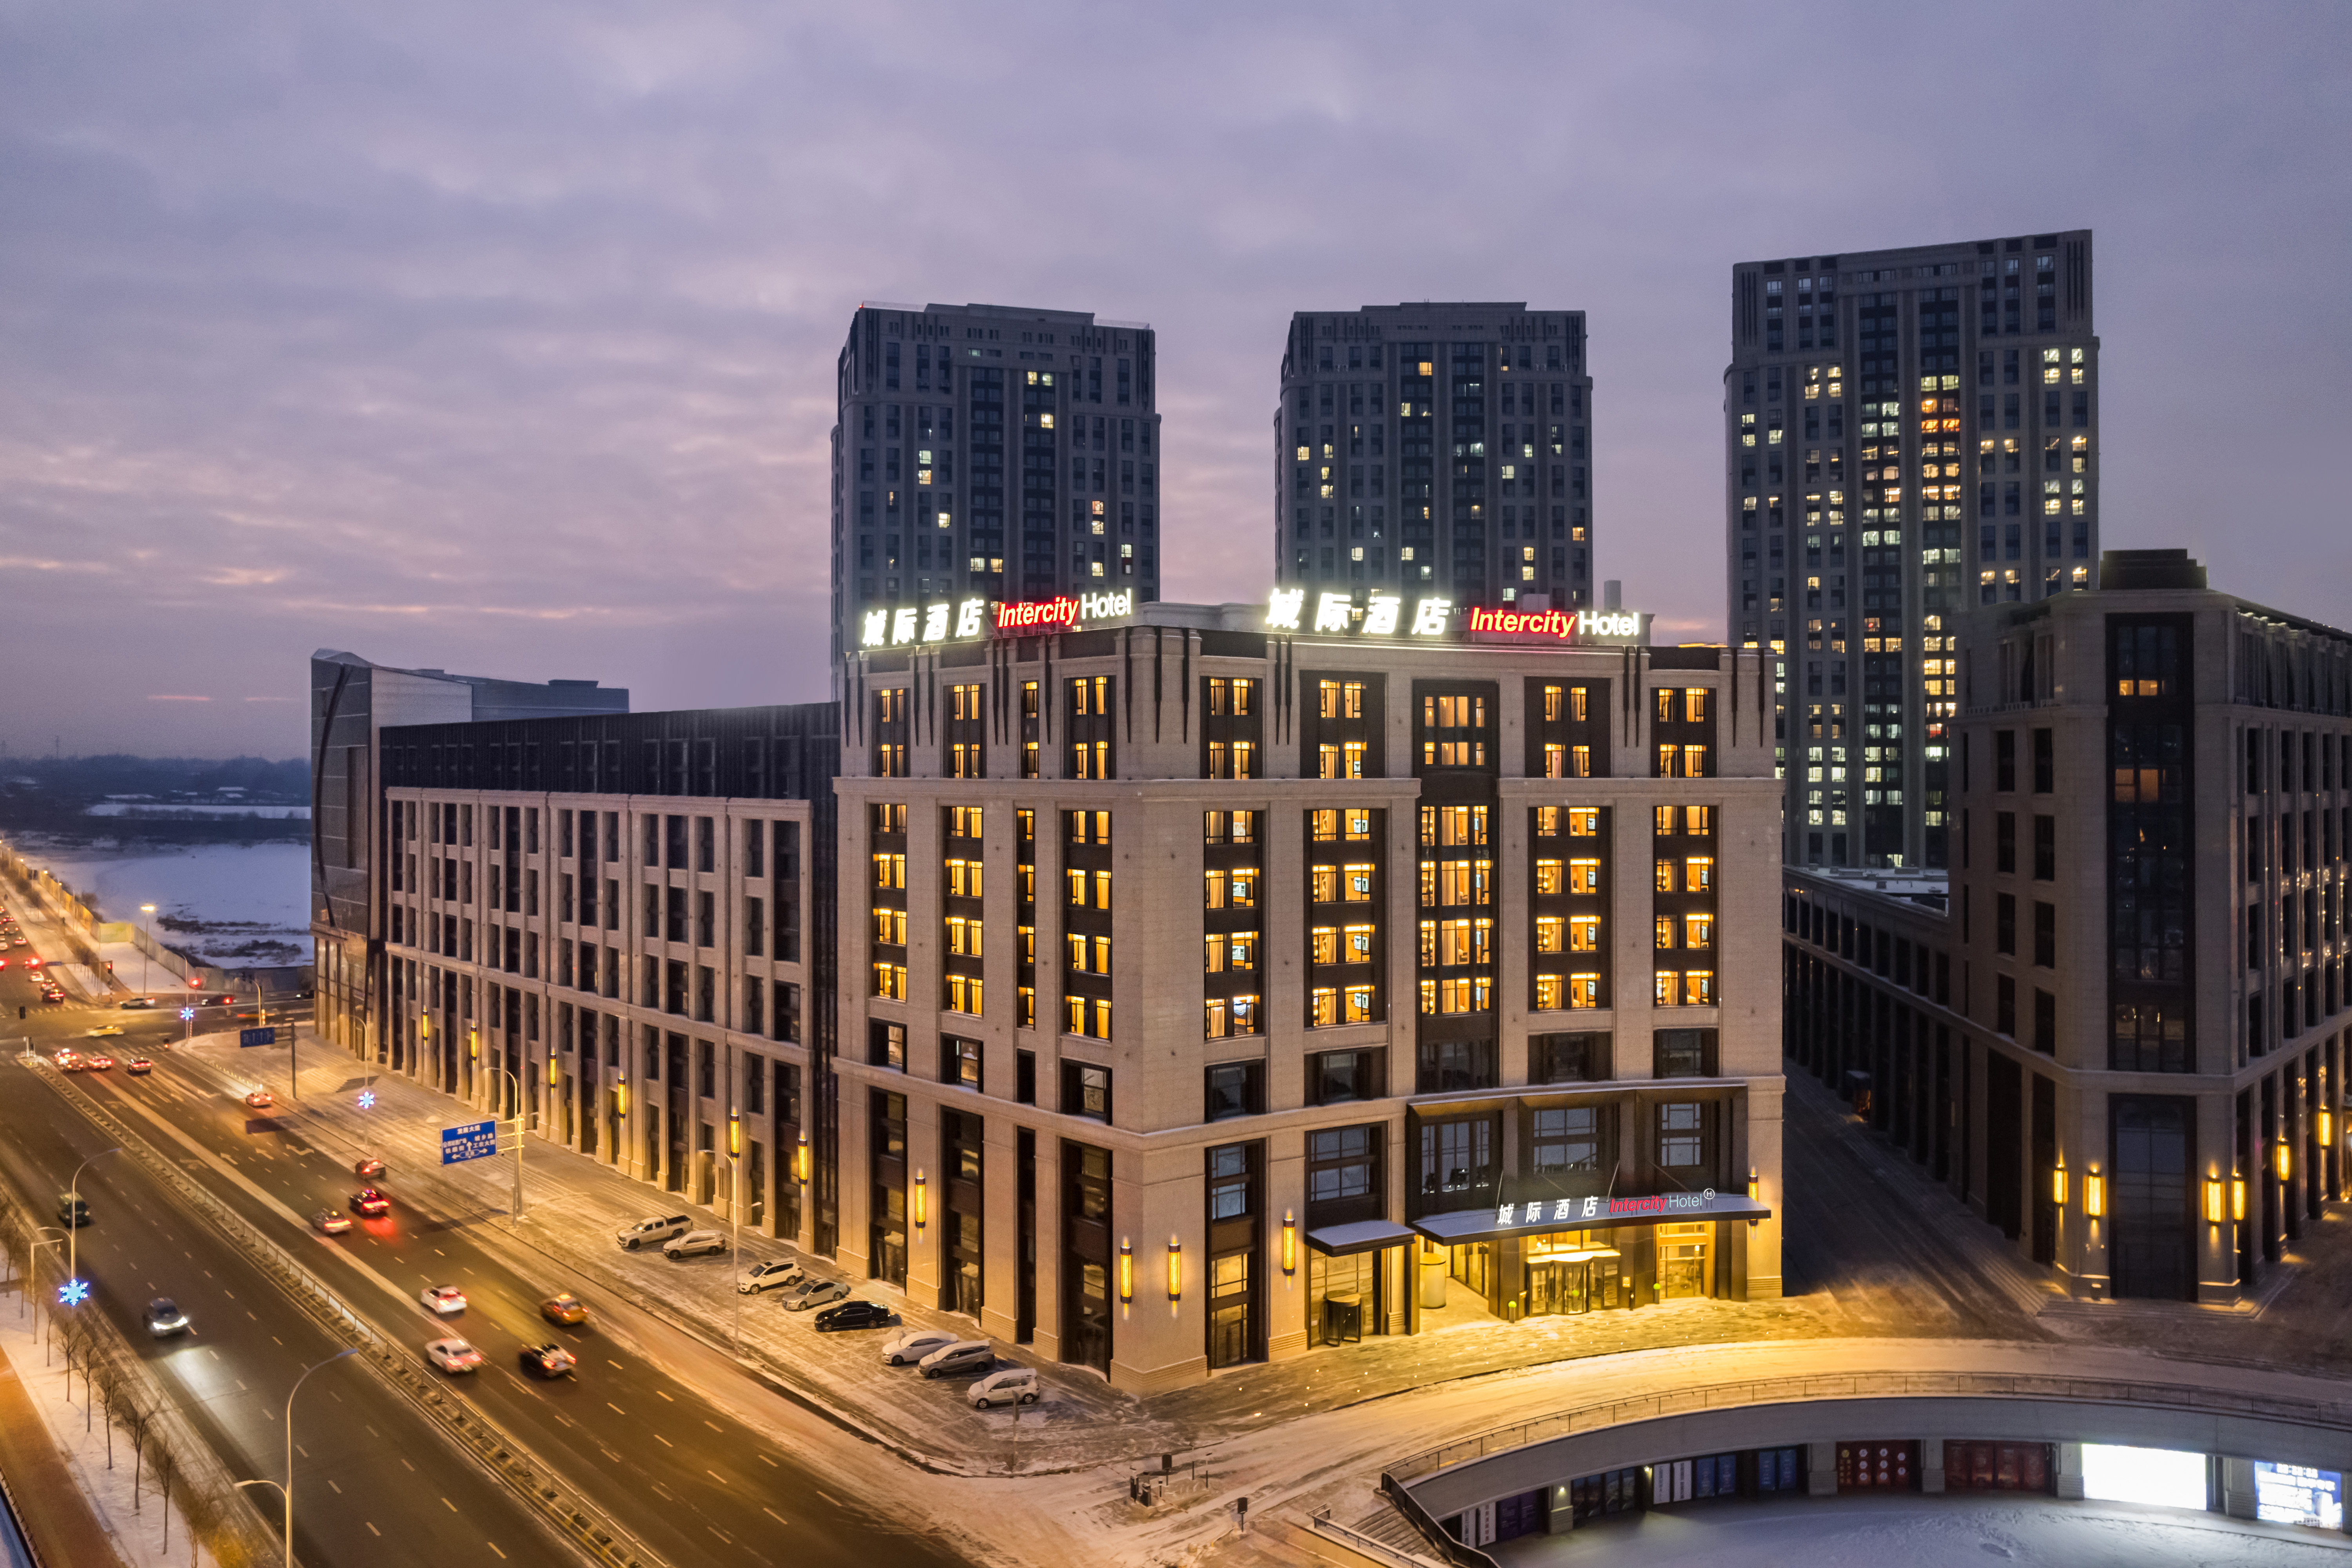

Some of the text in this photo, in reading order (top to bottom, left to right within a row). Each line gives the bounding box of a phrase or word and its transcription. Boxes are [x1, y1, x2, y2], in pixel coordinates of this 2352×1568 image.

[863, 598, 984, 647] 城际酒店
[1265, 588, 1451, 635] 城际酒店
[1497, 1196, 1598, 1225] 城际酒店
